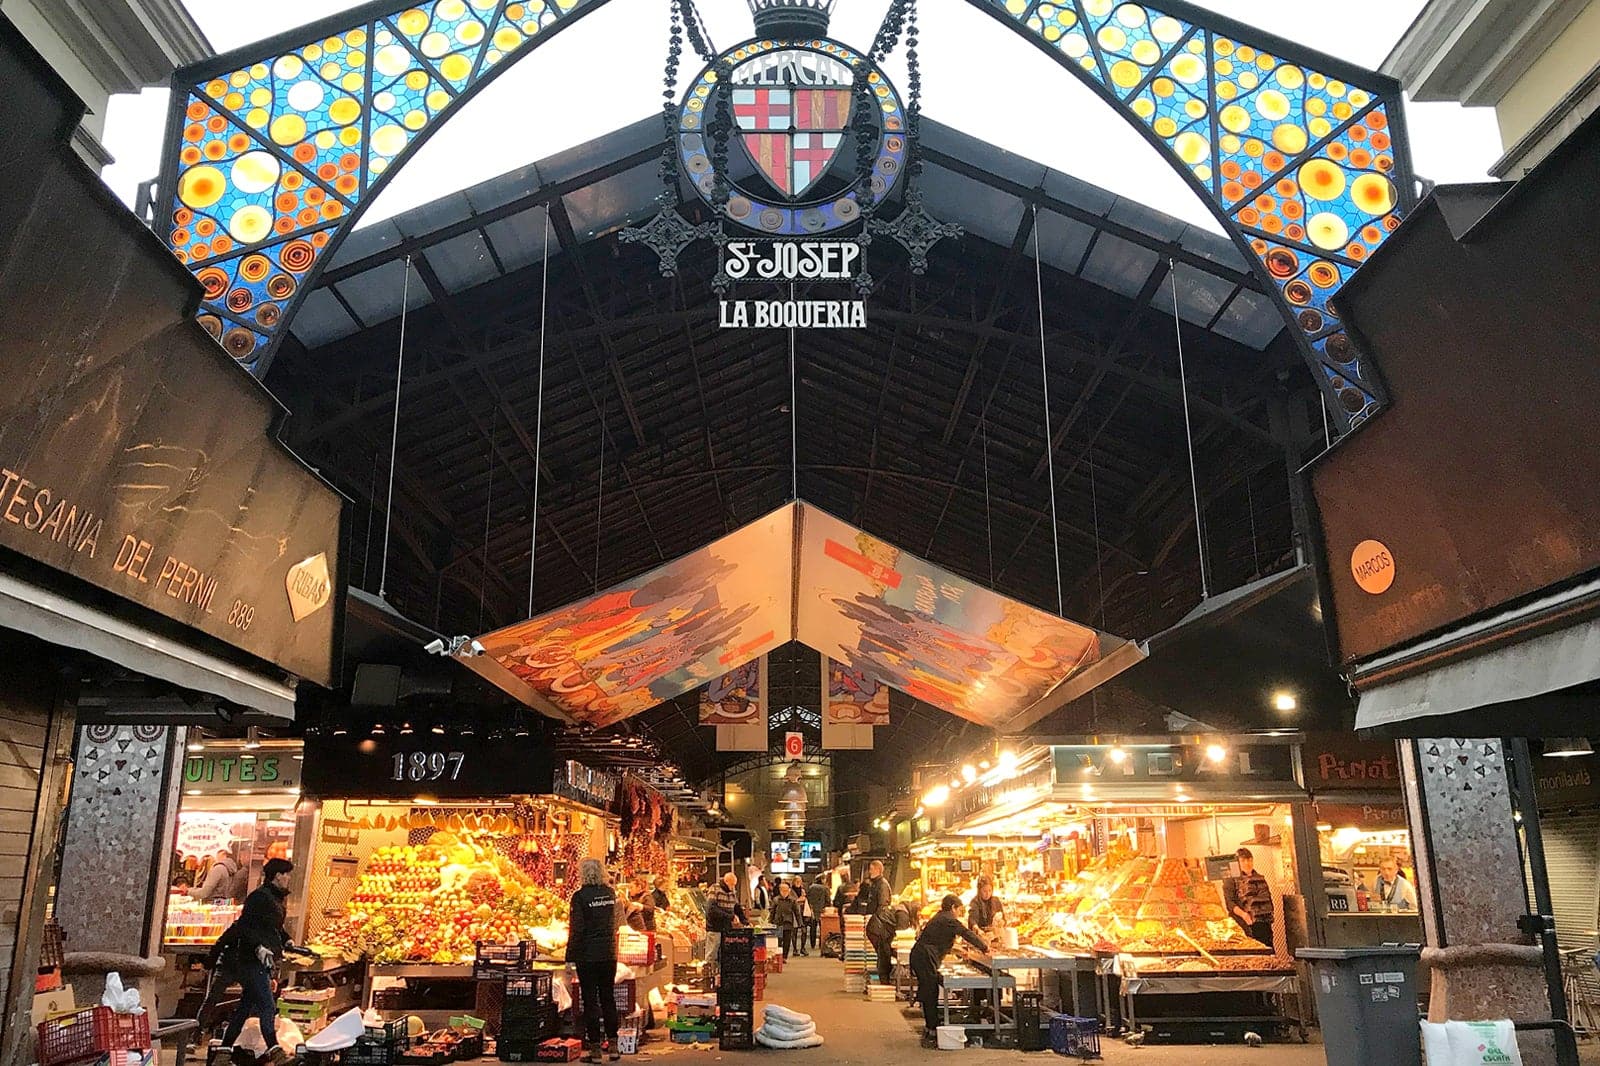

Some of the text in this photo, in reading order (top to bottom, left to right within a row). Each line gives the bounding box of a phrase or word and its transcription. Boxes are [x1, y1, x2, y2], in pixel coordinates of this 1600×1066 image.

[735, 51, 849, 86] MERCAT
[756, 242, 860, 279] JOSEP
[719, 300, 867, 328] LA BOQUERIA
[1355, 551, 1390, 580] MARCOS
[113, 534, 154, 583] DEL
[155, 556, 219, 614] PERNIL
[228, 599, 255, 631] 889
[292, 568, 326, 605] RIBAS
[390, 751, 465, 781] 1897
[1330, 898, 1348, 910] RB
